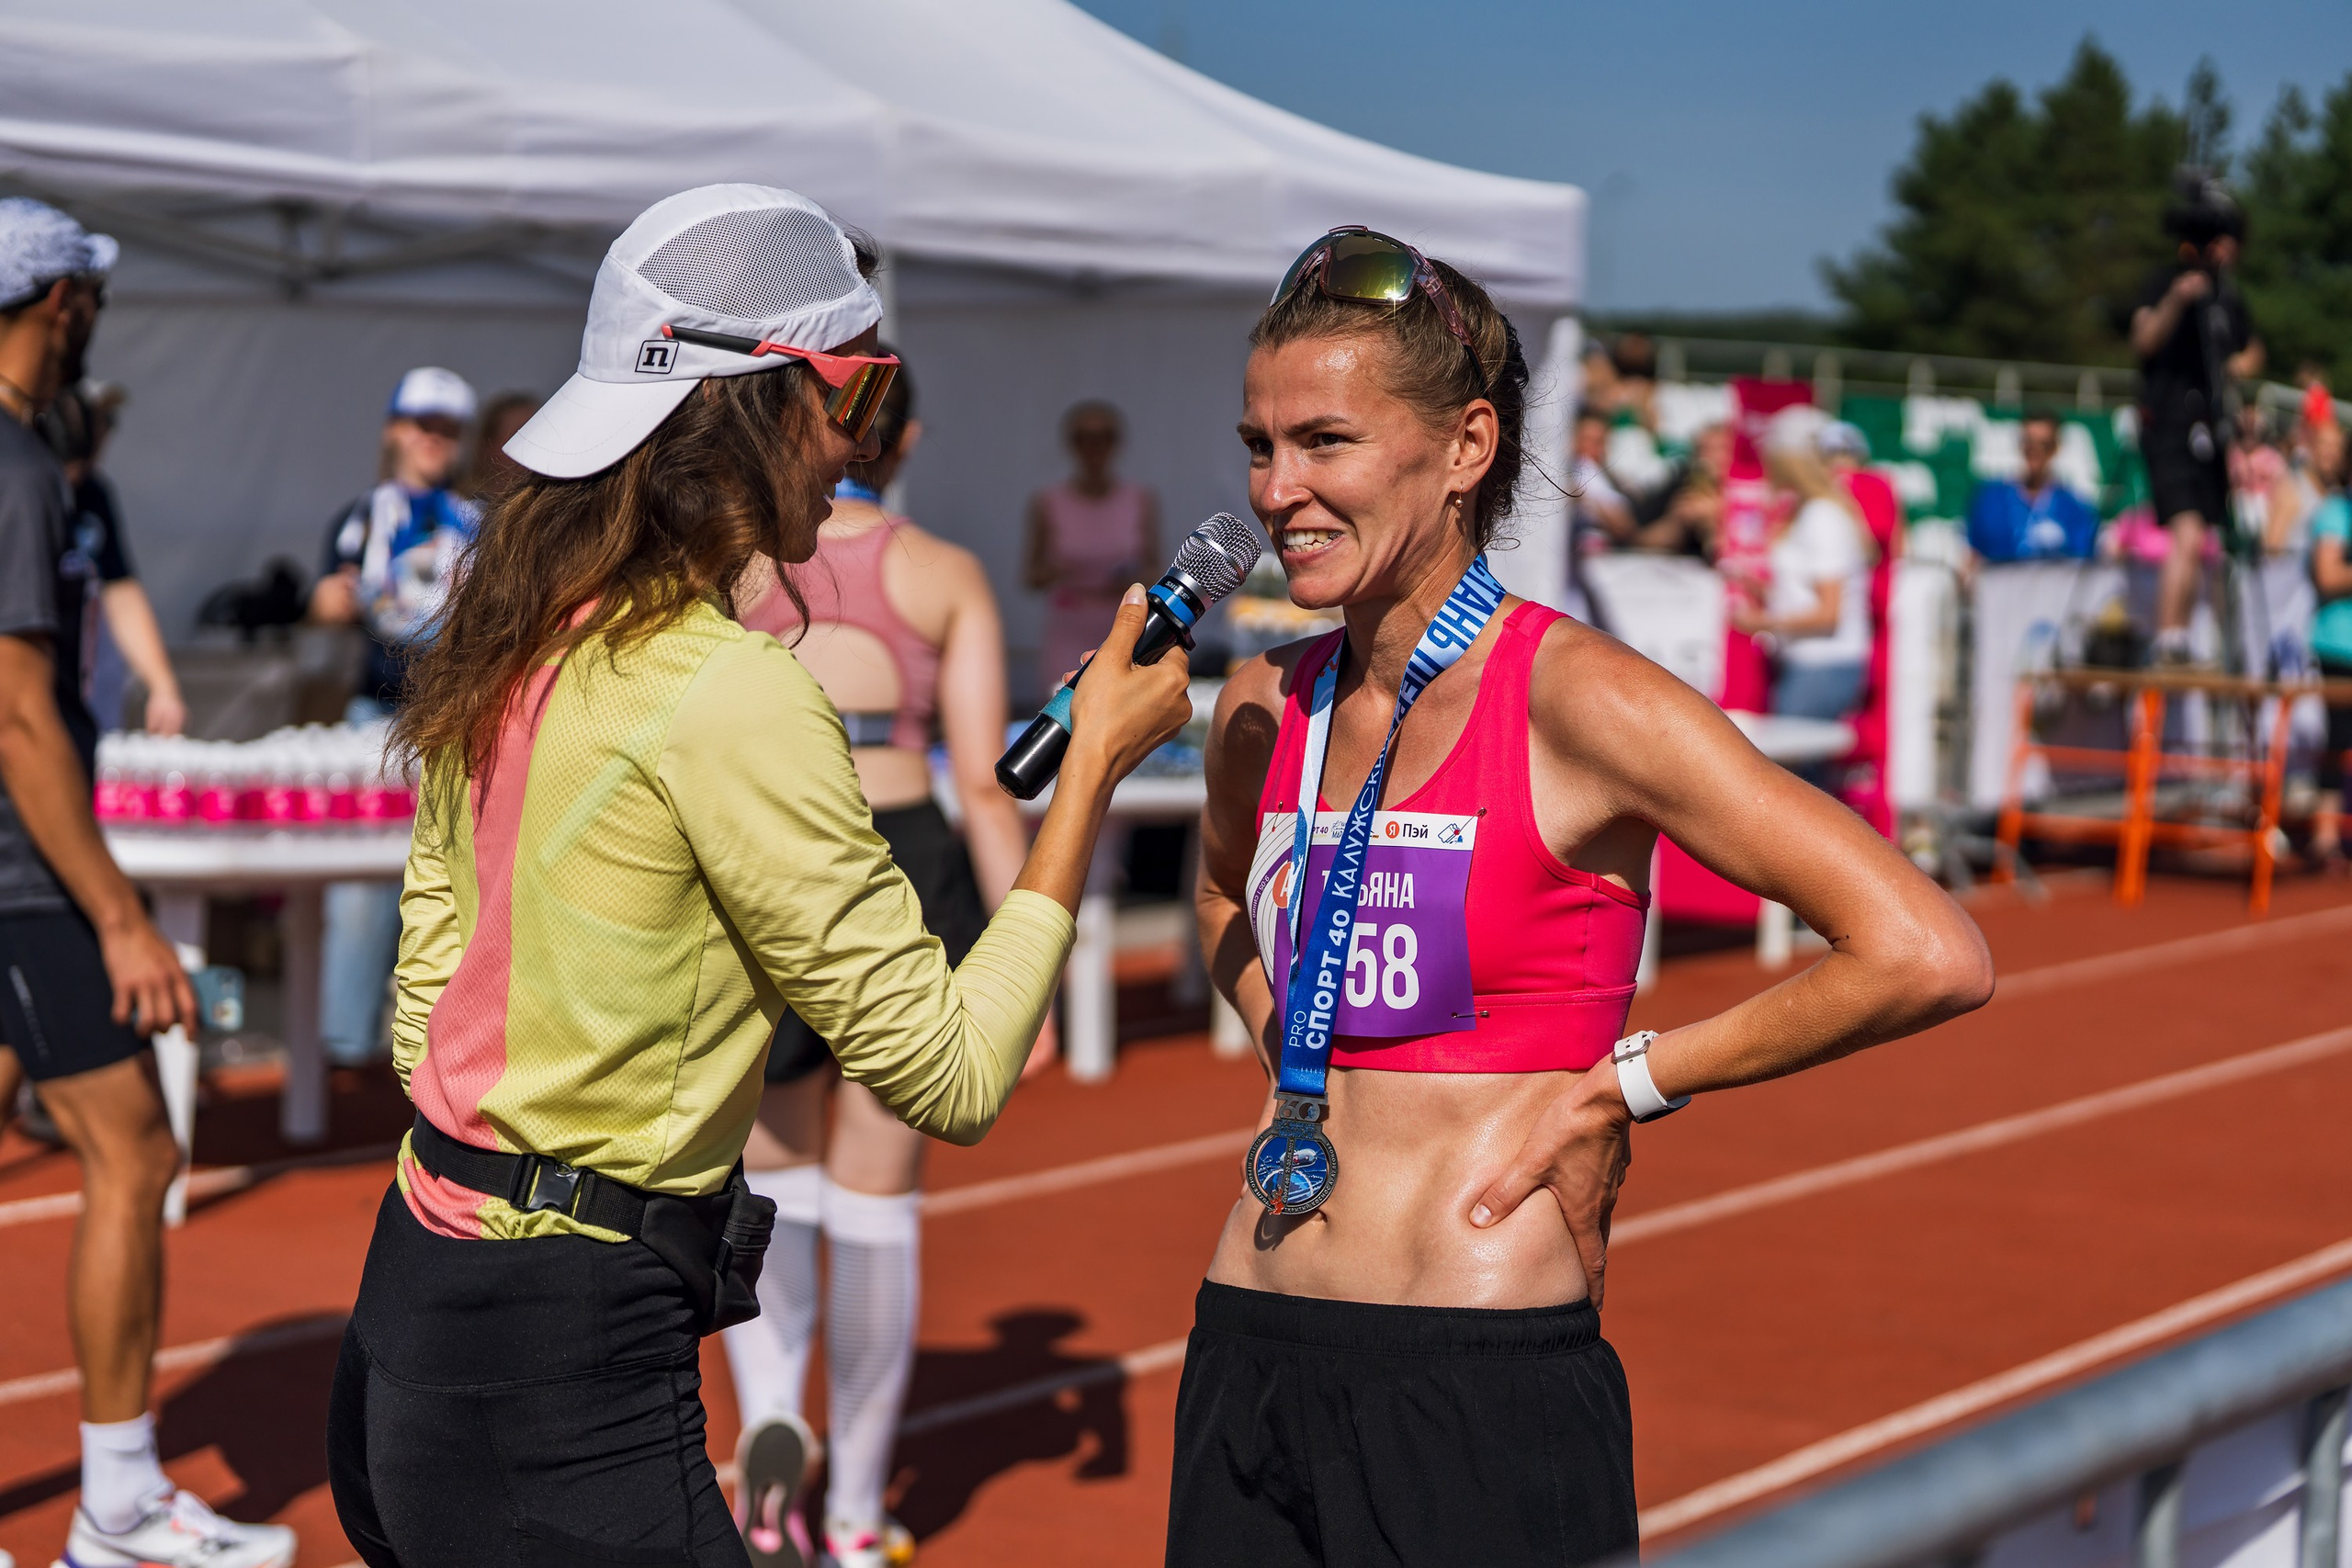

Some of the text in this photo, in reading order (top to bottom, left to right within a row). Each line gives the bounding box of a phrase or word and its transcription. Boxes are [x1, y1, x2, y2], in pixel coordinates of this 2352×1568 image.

[1402, 823, 1429, 839] Пэй
[1306, 950, 1341, 1050] СПОРТ
[1329, 909, 1351, 947] 40
[1345, 921, 1420, 1010] 58
[1288, 1010, 1306, 1047] PRO
[1279, 1100, 1321, 1122] 60
